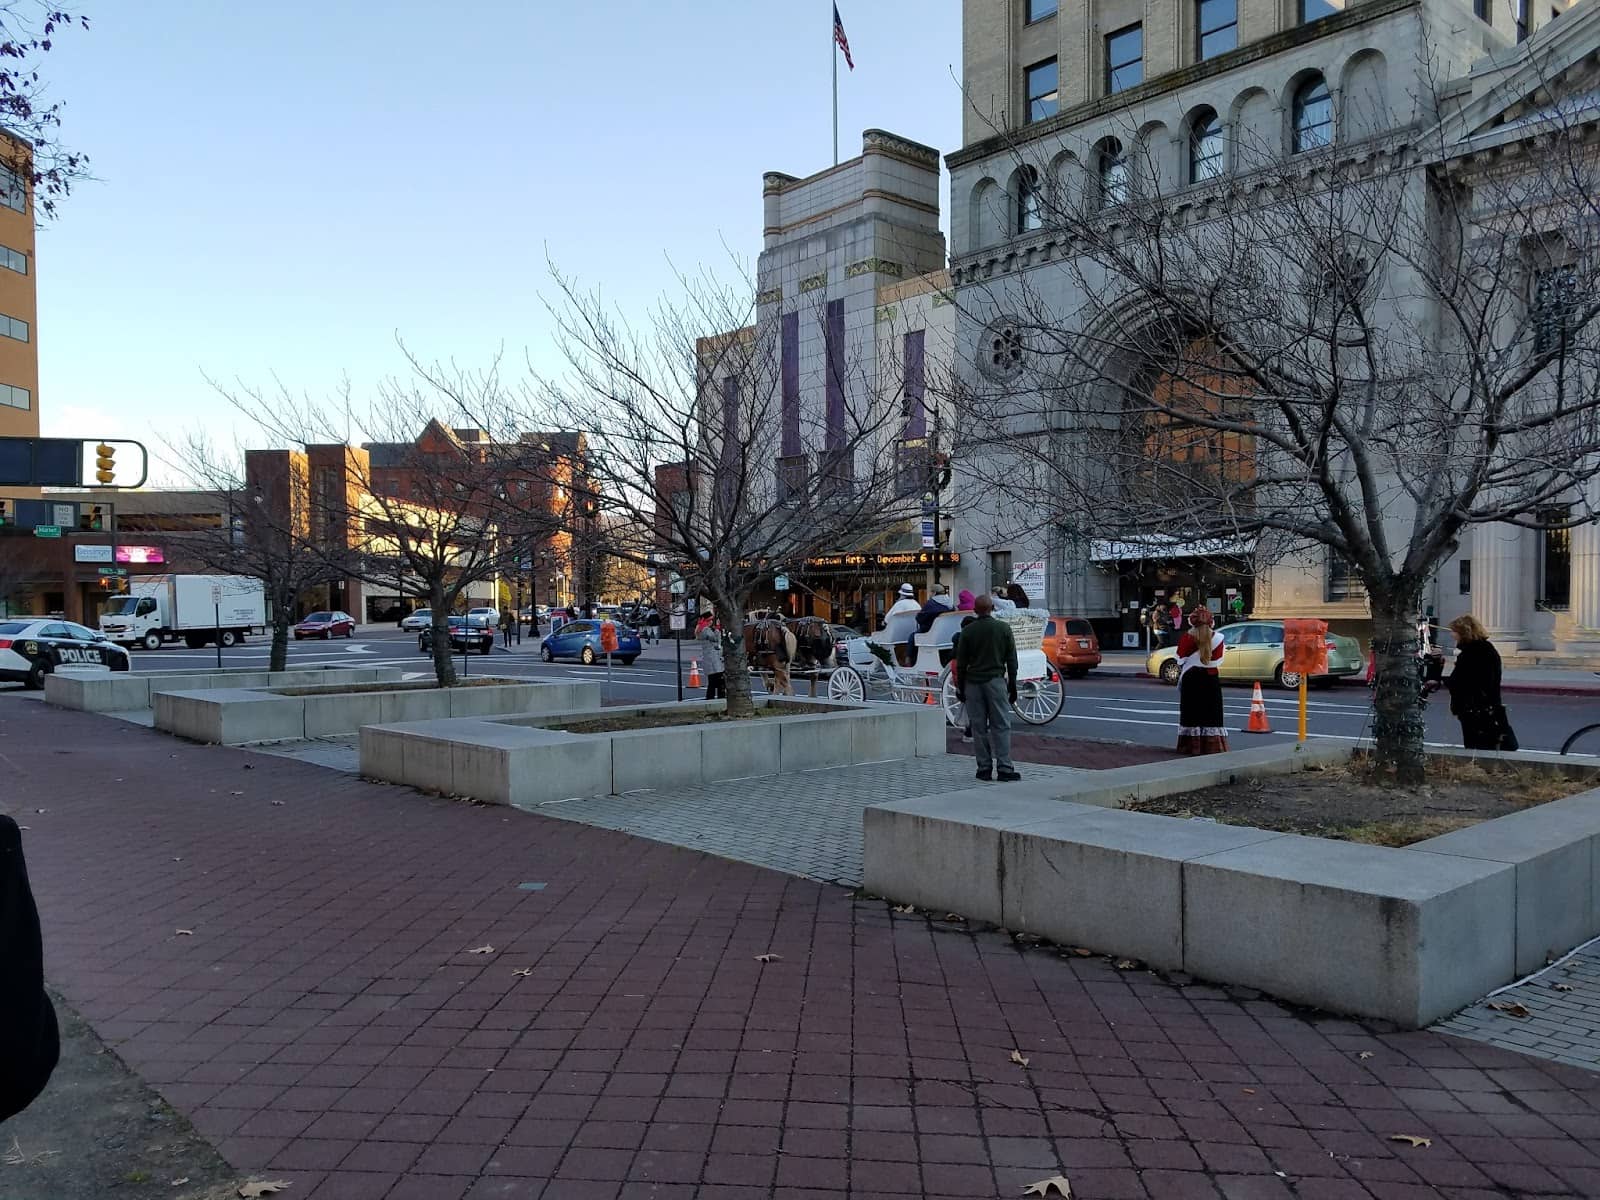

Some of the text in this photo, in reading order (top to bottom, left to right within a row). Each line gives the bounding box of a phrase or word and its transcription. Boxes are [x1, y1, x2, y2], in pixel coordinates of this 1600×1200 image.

[845, 554, 865, 564] Arts
[877, 554, 916, 565] December
[919, 553, 928, 562] 6
[57, 648, 102, 663] POLICE
